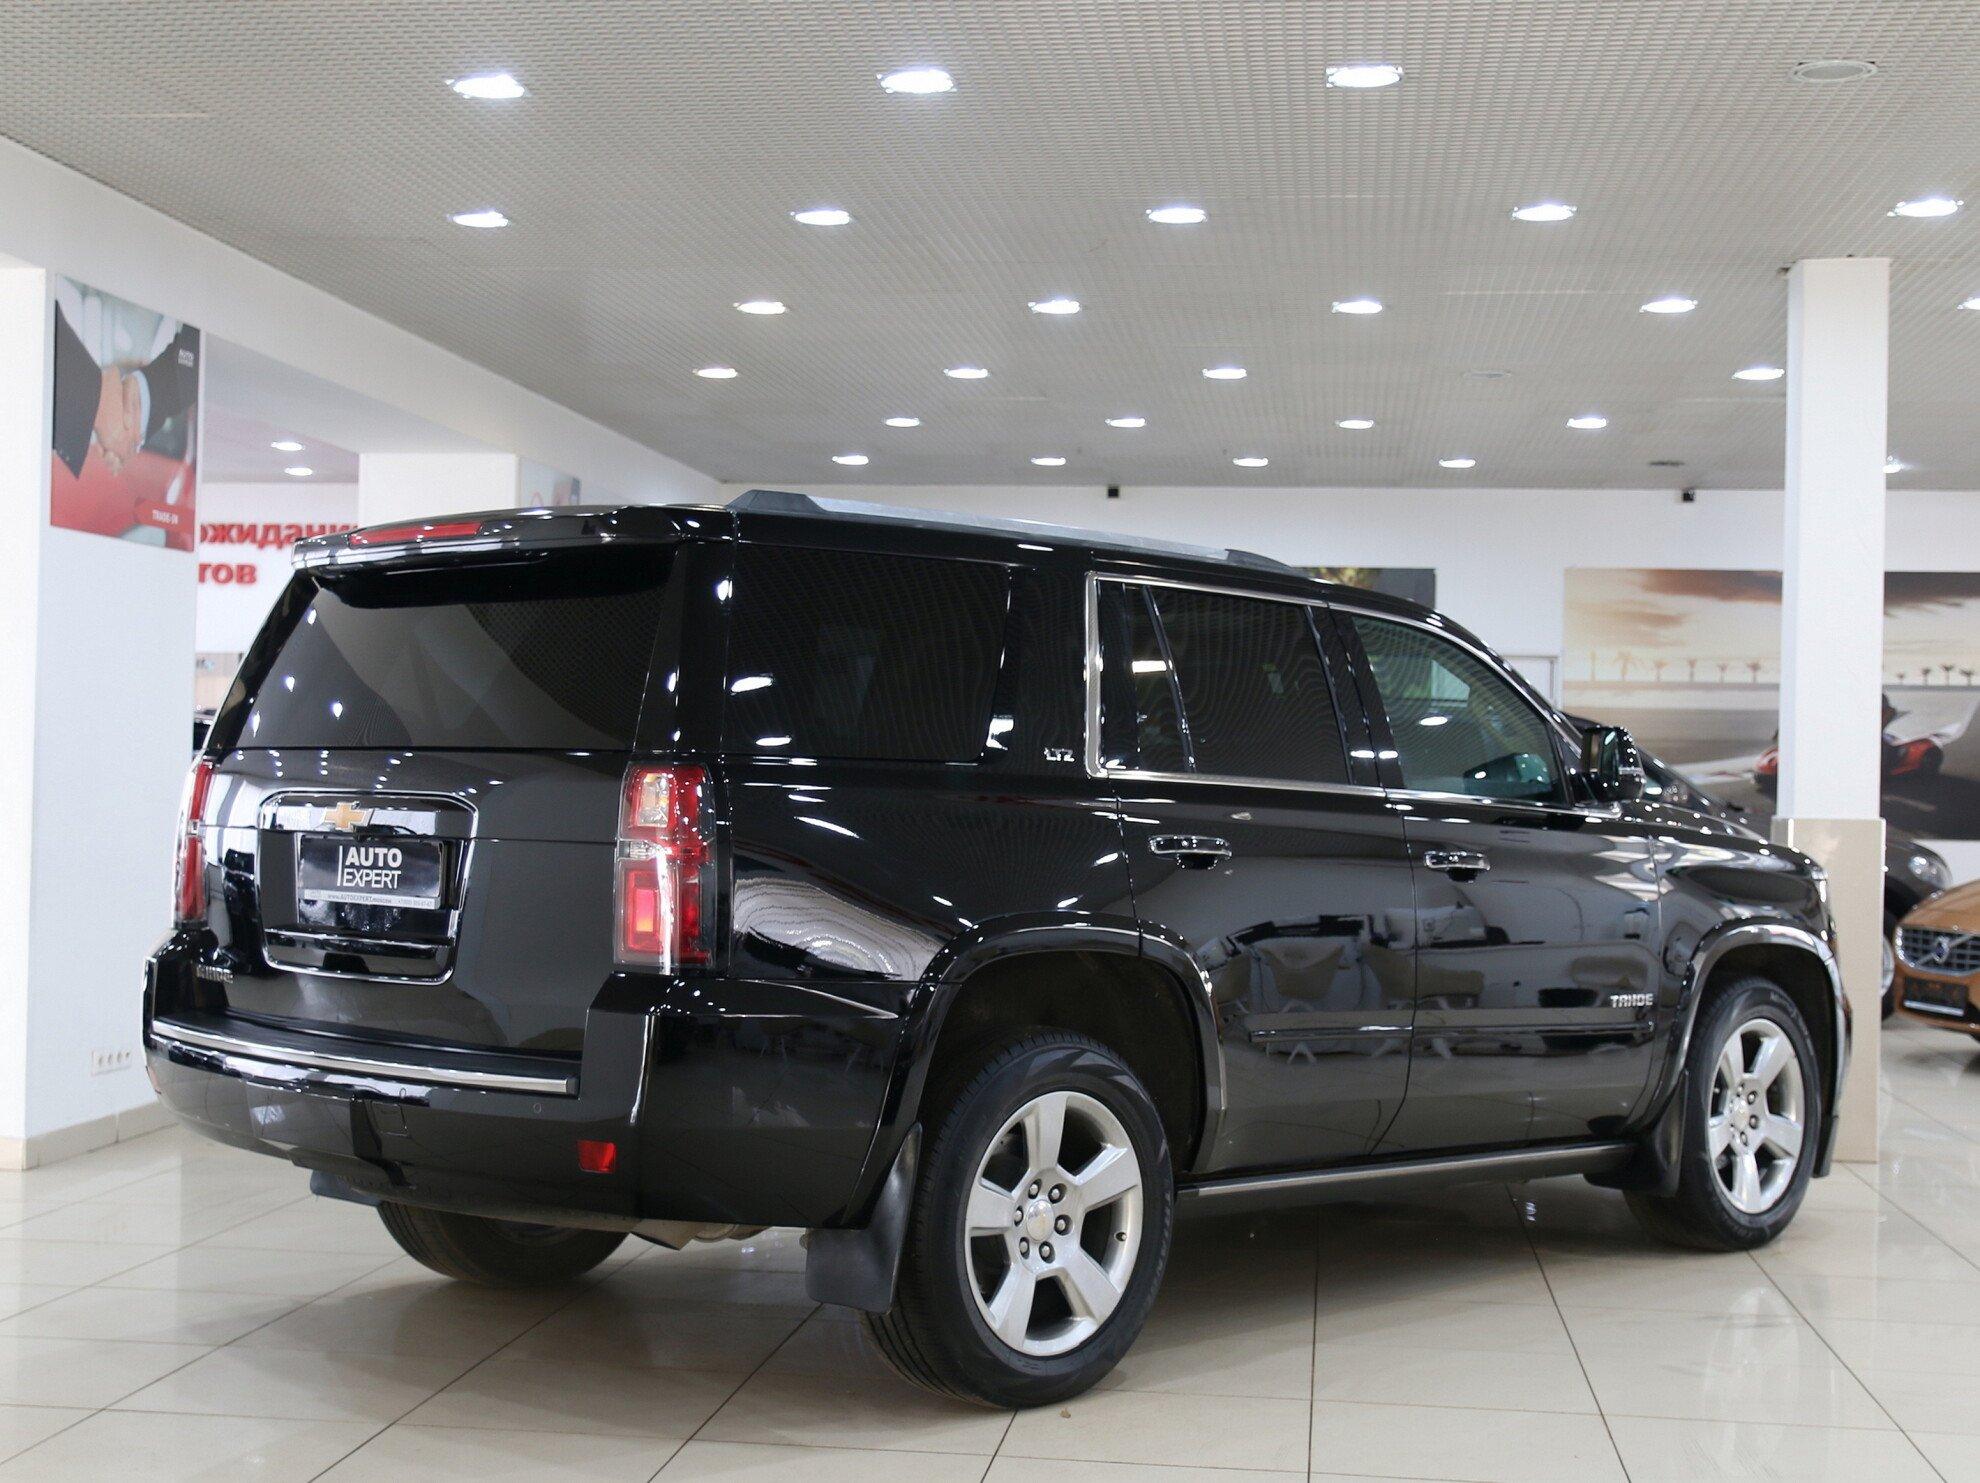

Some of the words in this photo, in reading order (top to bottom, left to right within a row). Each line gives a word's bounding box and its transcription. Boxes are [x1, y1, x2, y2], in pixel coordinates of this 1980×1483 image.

[345, 846, 403, 868] AUTO
[343, 868, 401, 889] EXPERT
[1610, 993, 1653, 1008] TAHOE
